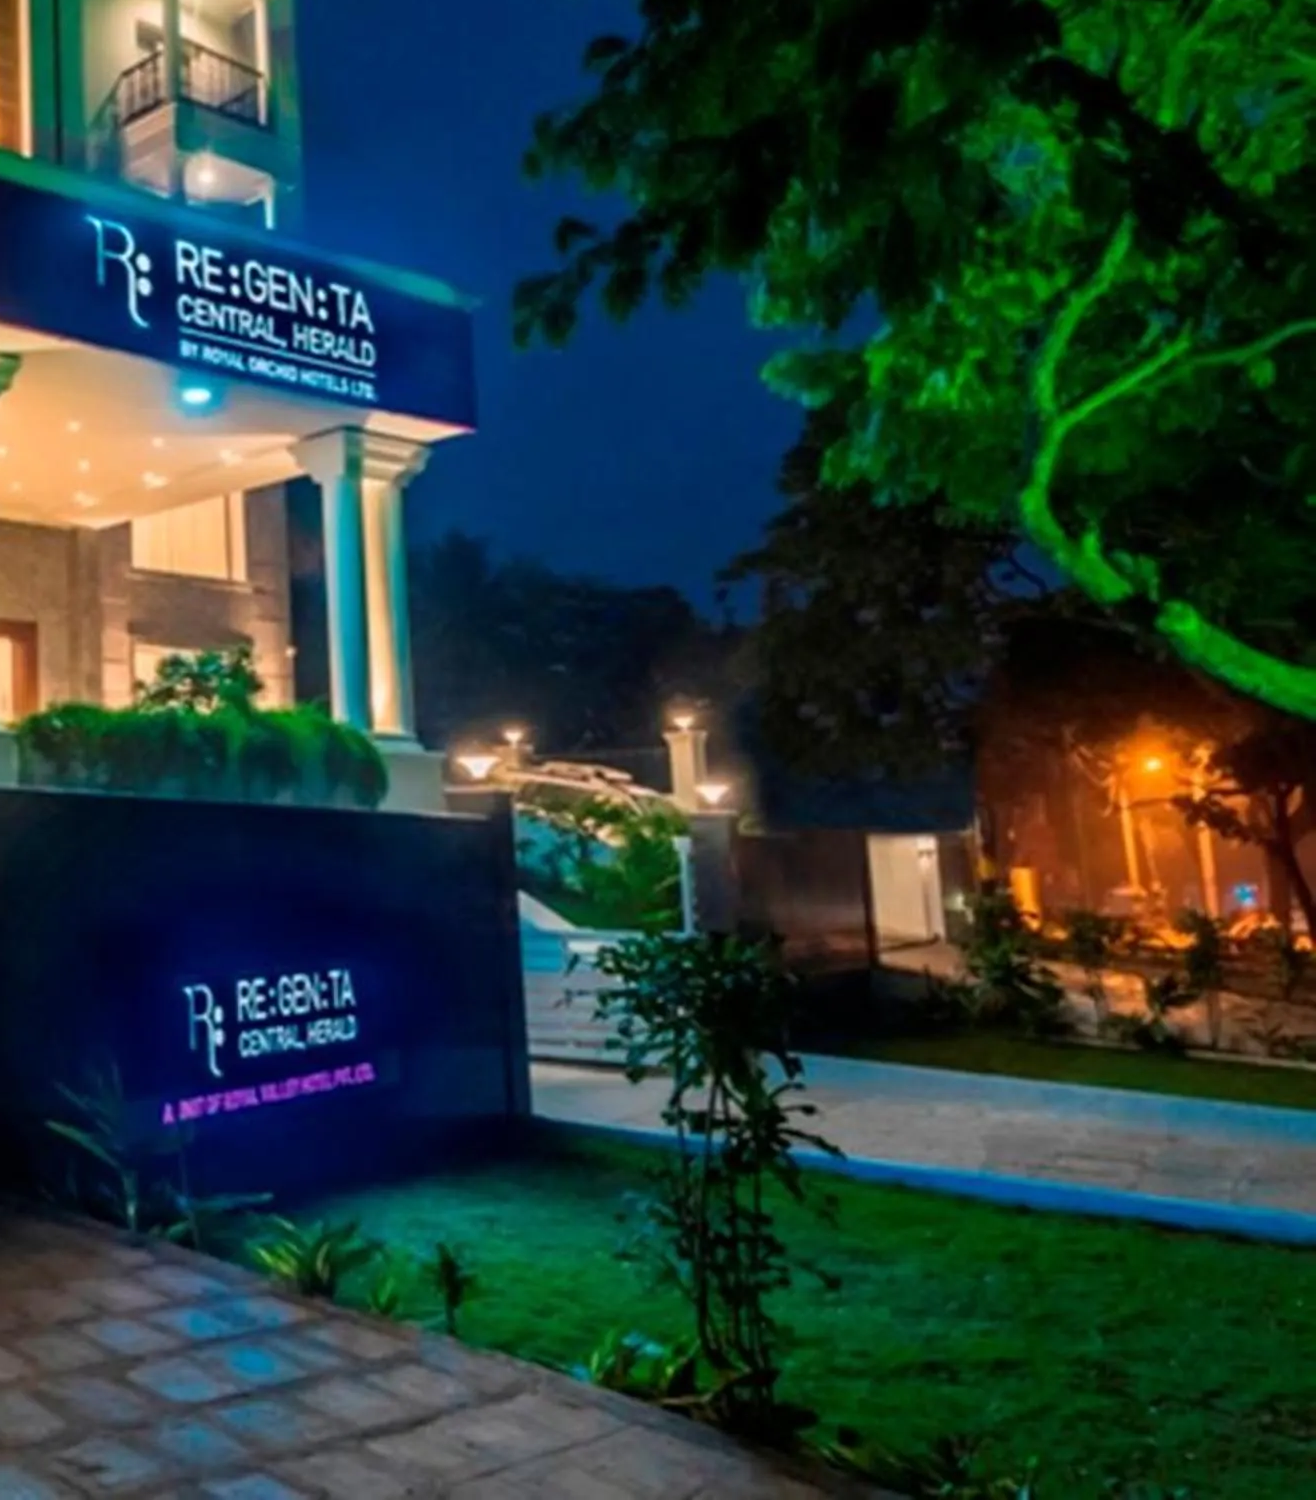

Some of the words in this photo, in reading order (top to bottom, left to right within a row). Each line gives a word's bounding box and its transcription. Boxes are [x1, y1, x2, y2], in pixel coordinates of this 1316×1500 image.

[175, 239, 376, 333] RE:GEN:TA
[177, 294, 288, 347] CENTRAL
[292, 320, 377, 367] HERALD
[202, 345, 246, 372] ROYAL
[237, 969, 357, 1022] RE:GEN:TA
[239, 1025, 306, 1057] CENTRAL
